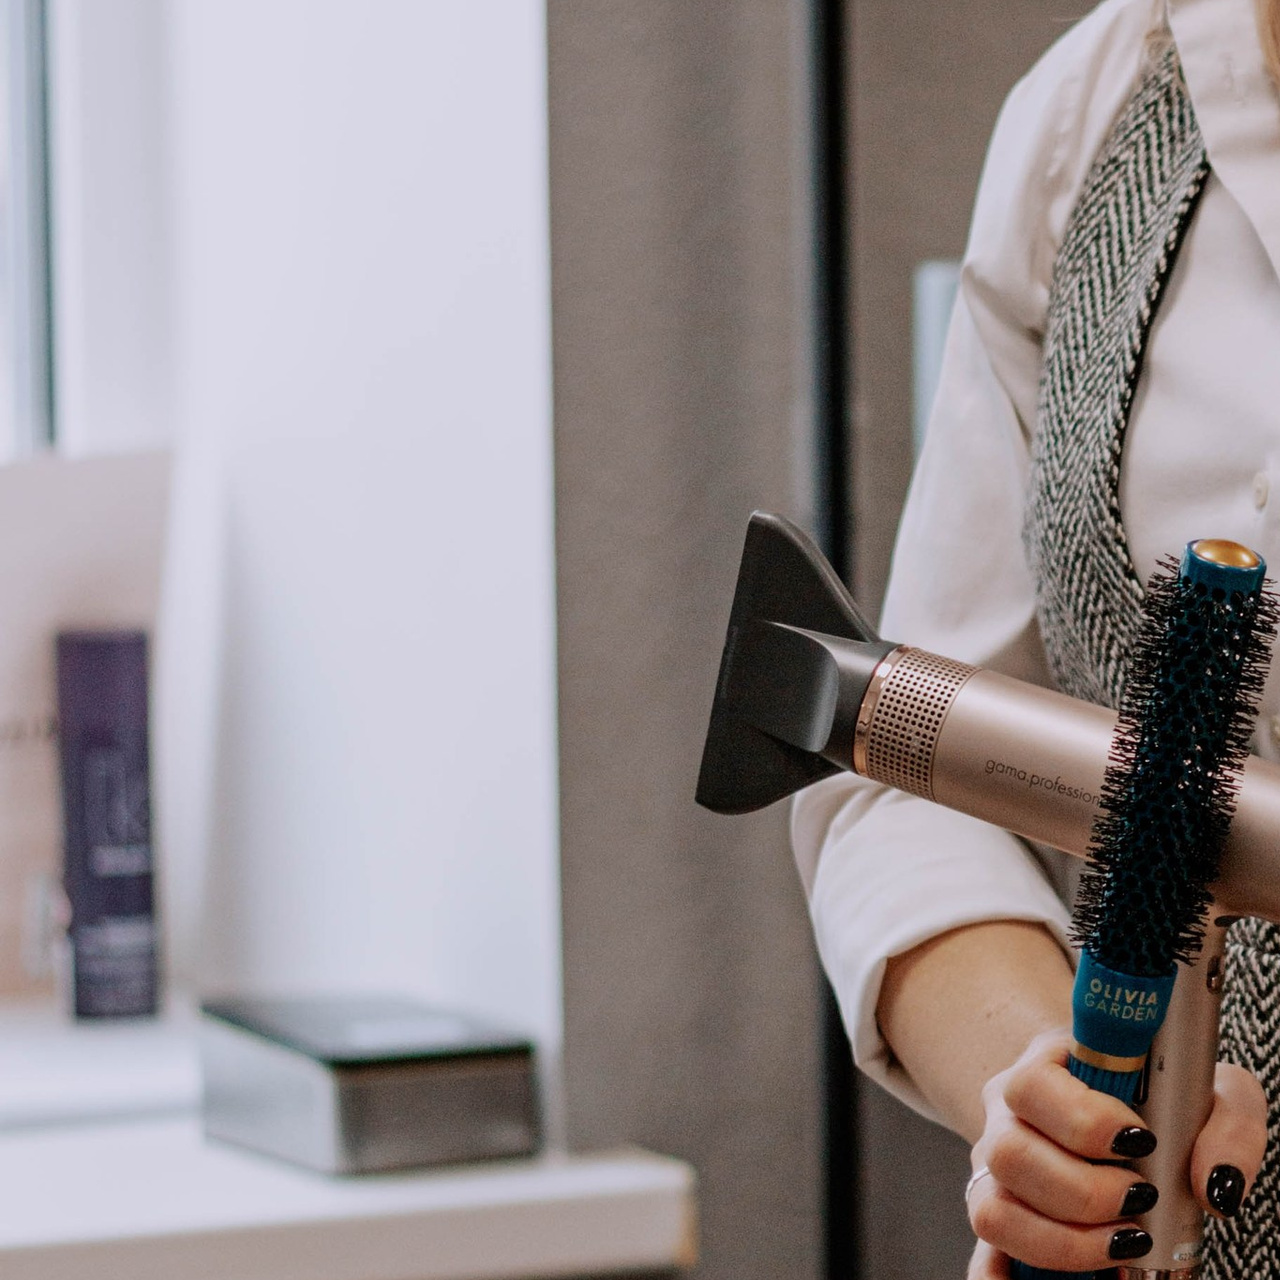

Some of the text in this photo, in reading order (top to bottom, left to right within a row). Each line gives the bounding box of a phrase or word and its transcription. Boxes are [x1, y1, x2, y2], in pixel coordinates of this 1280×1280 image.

[985, 759, 1101, 806] gama.profession
[1090, 978, 1157, 1005] OLIVIA
[1085, 993, 1157, 1020] GARDEN
